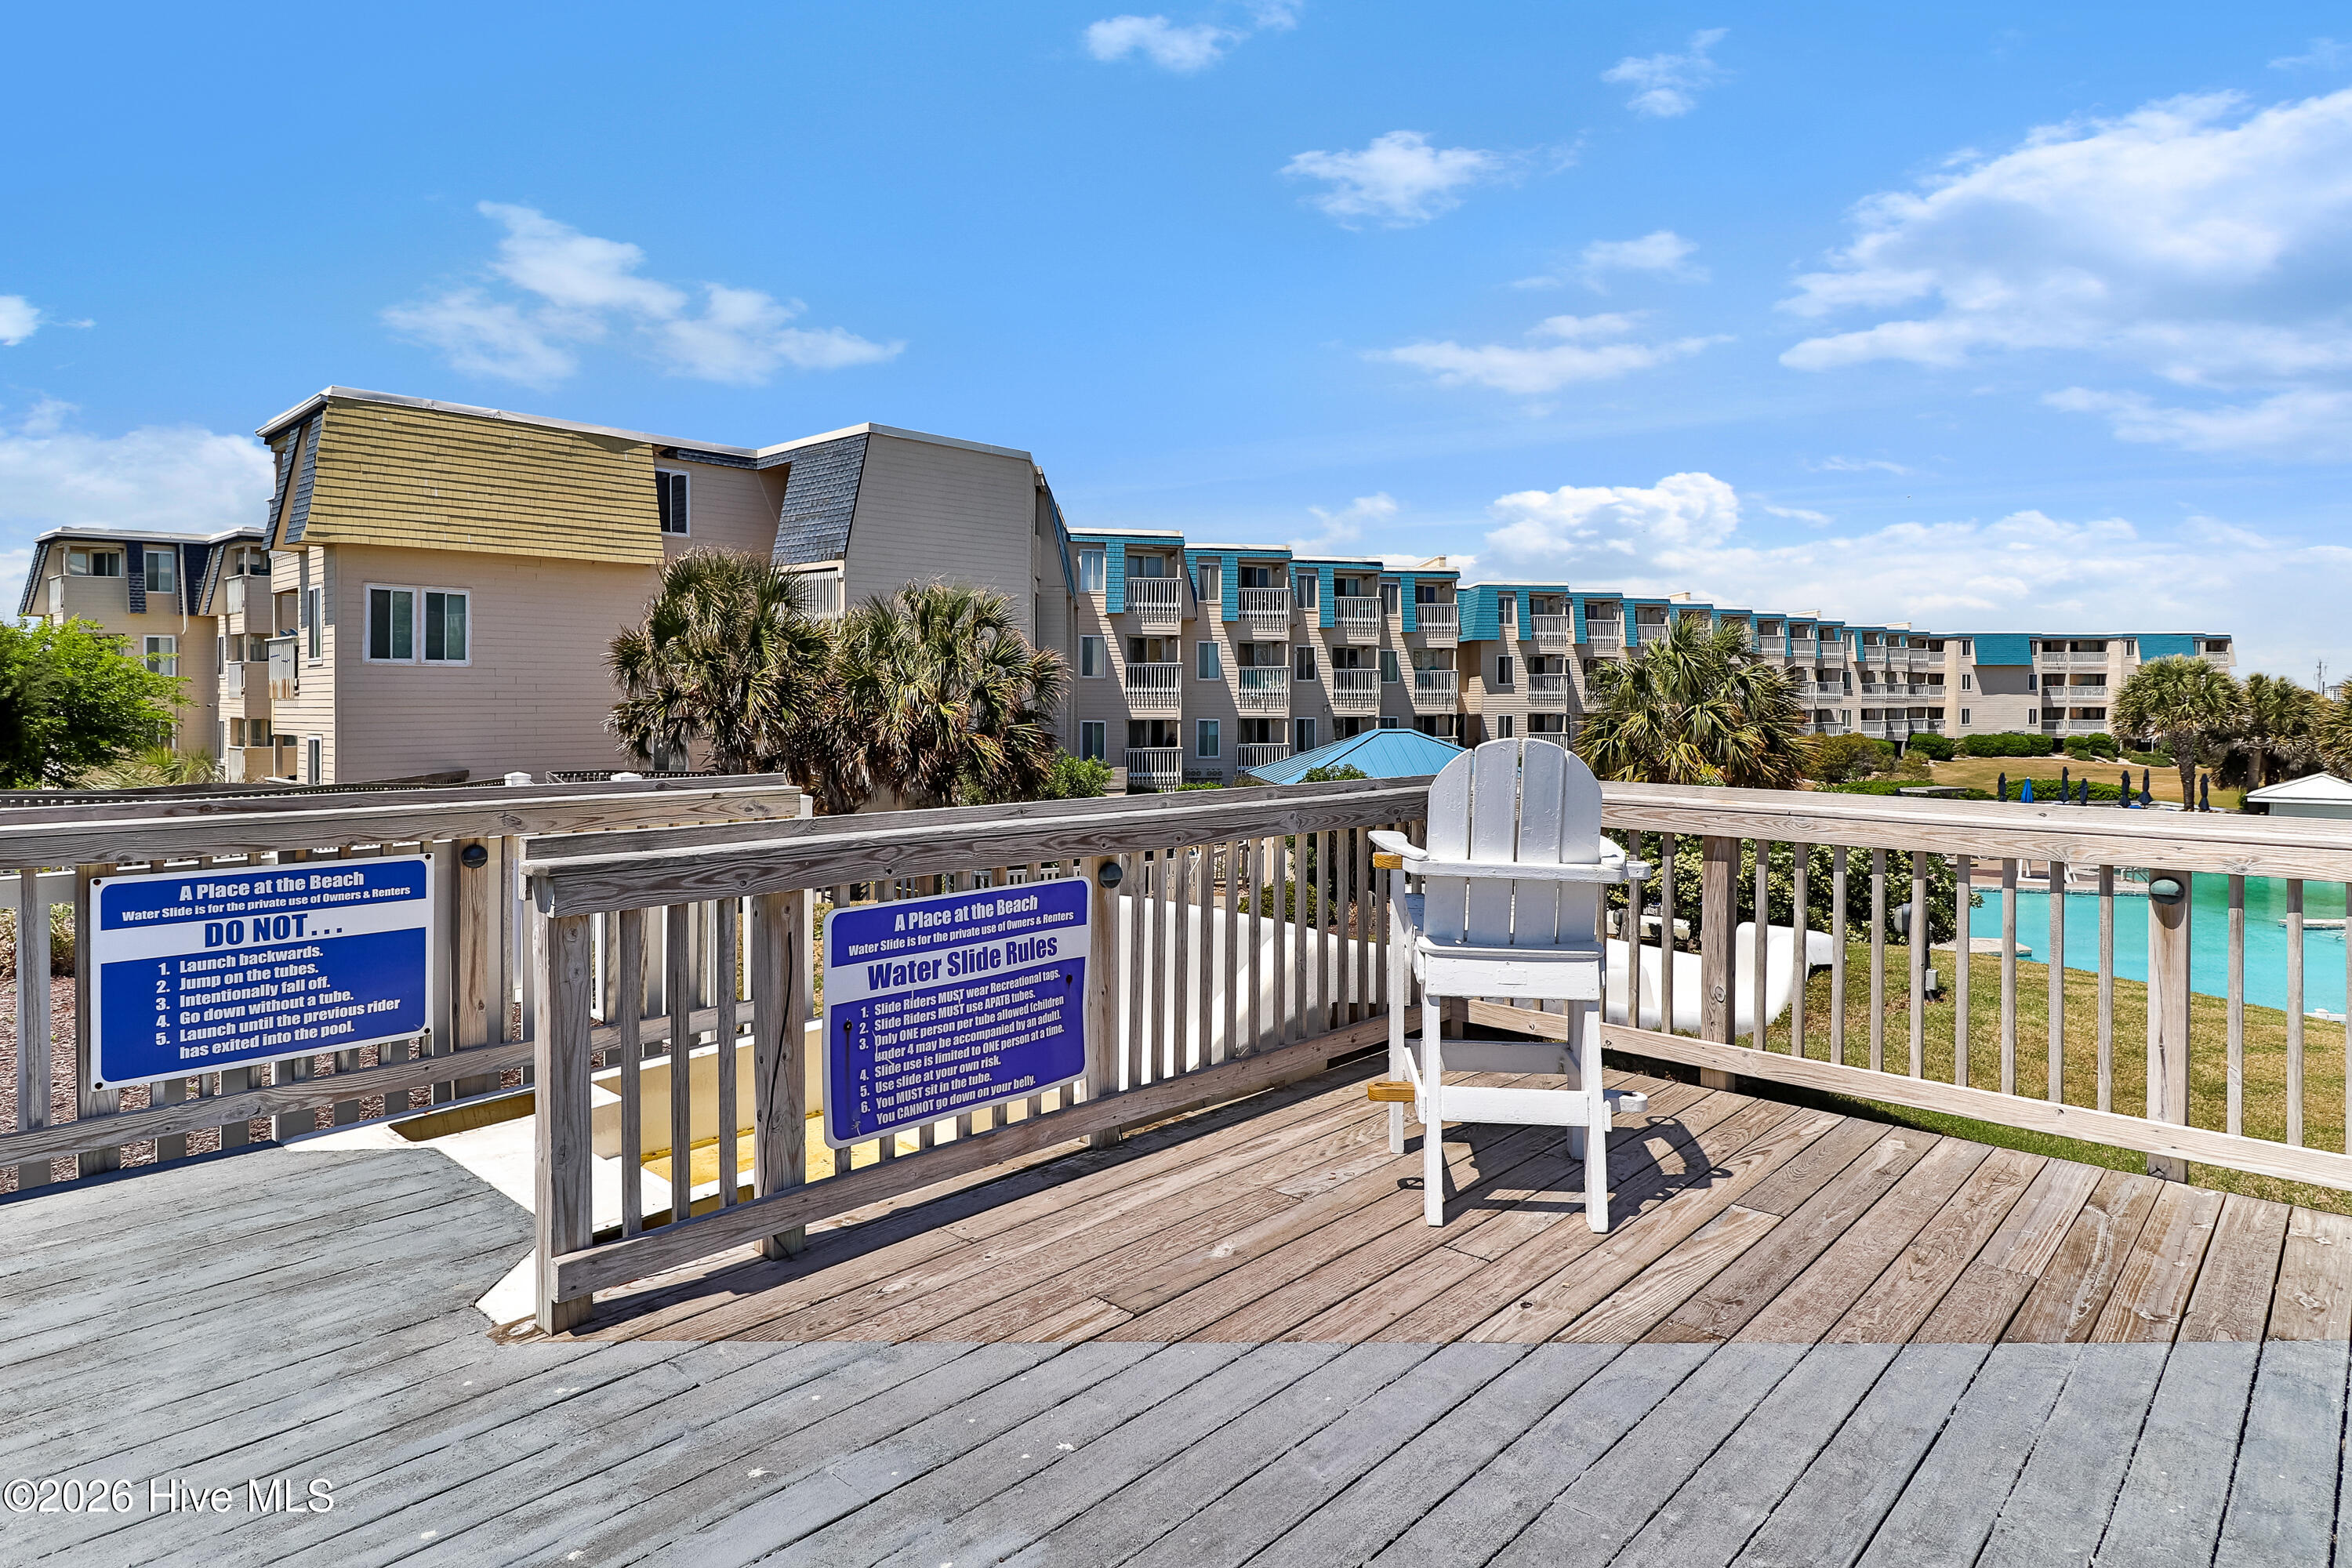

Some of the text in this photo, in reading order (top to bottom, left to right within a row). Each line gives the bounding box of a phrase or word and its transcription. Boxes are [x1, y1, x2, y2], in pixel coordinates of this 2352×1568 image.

[122, 909, 160, 921] Water
[162, 907, 193, 917] Slide
[195, 906, 205, 914] is
[208, 904, 224, 913] for
[227, 902, 245, 912] the
[248, 898, 286, 912] private
[289, 896, 308, 906] use
[310, 895, 321, 904] of
[322, 891, 361, 902] Owners
[372, 887, 411, 898] Renters
[179, 871, 364, 901] A Place at the Beach
[848, 911, 1073, 956] Water Slide is for the private use of Owners & Renters
[895, 895, 1038, 931] A Place at the Beach
[205, 920, 245, 948] DO
[157, 963, 318, 993] 2. Jump on the tubes.
[158, 946, 324, 975] 1. Launch backwards.
[868, 936, 1058, 991] Water Slide Rules
[156, 976, 330, 1011] 3. Intentionally fall off.
[156, 990, 354, 1028] 4. Go down without a tube.
[859, 989, 1035, 1034] 2. Slide Riders MUST use APATB tubes.
[861, 970, 1060, 1018] 1. Slide Riders MUST wear Recreational tags.
[155, 998, 401, 1046] 5. Launch until the previous rider
[180, 1021, 354, 1060] has exited into the pool.
[859, 996, 1064, 1050] 3. Only ONE person per tube allowed (children
[875, 1010, 1062, 1062] under 4 may be accompanied by an adult).
[860, 1024, 1064, 1080] 4. Slide use is limited to ONE person at a time.
[860, 1055, 1001, 1097] 5. Use slide at your own risk.
[861, 1073, 992, 1113] 6. You MUST sit in the tube.
[877, 1076, 1035, 1124] You CANNOT go down on your belly.
